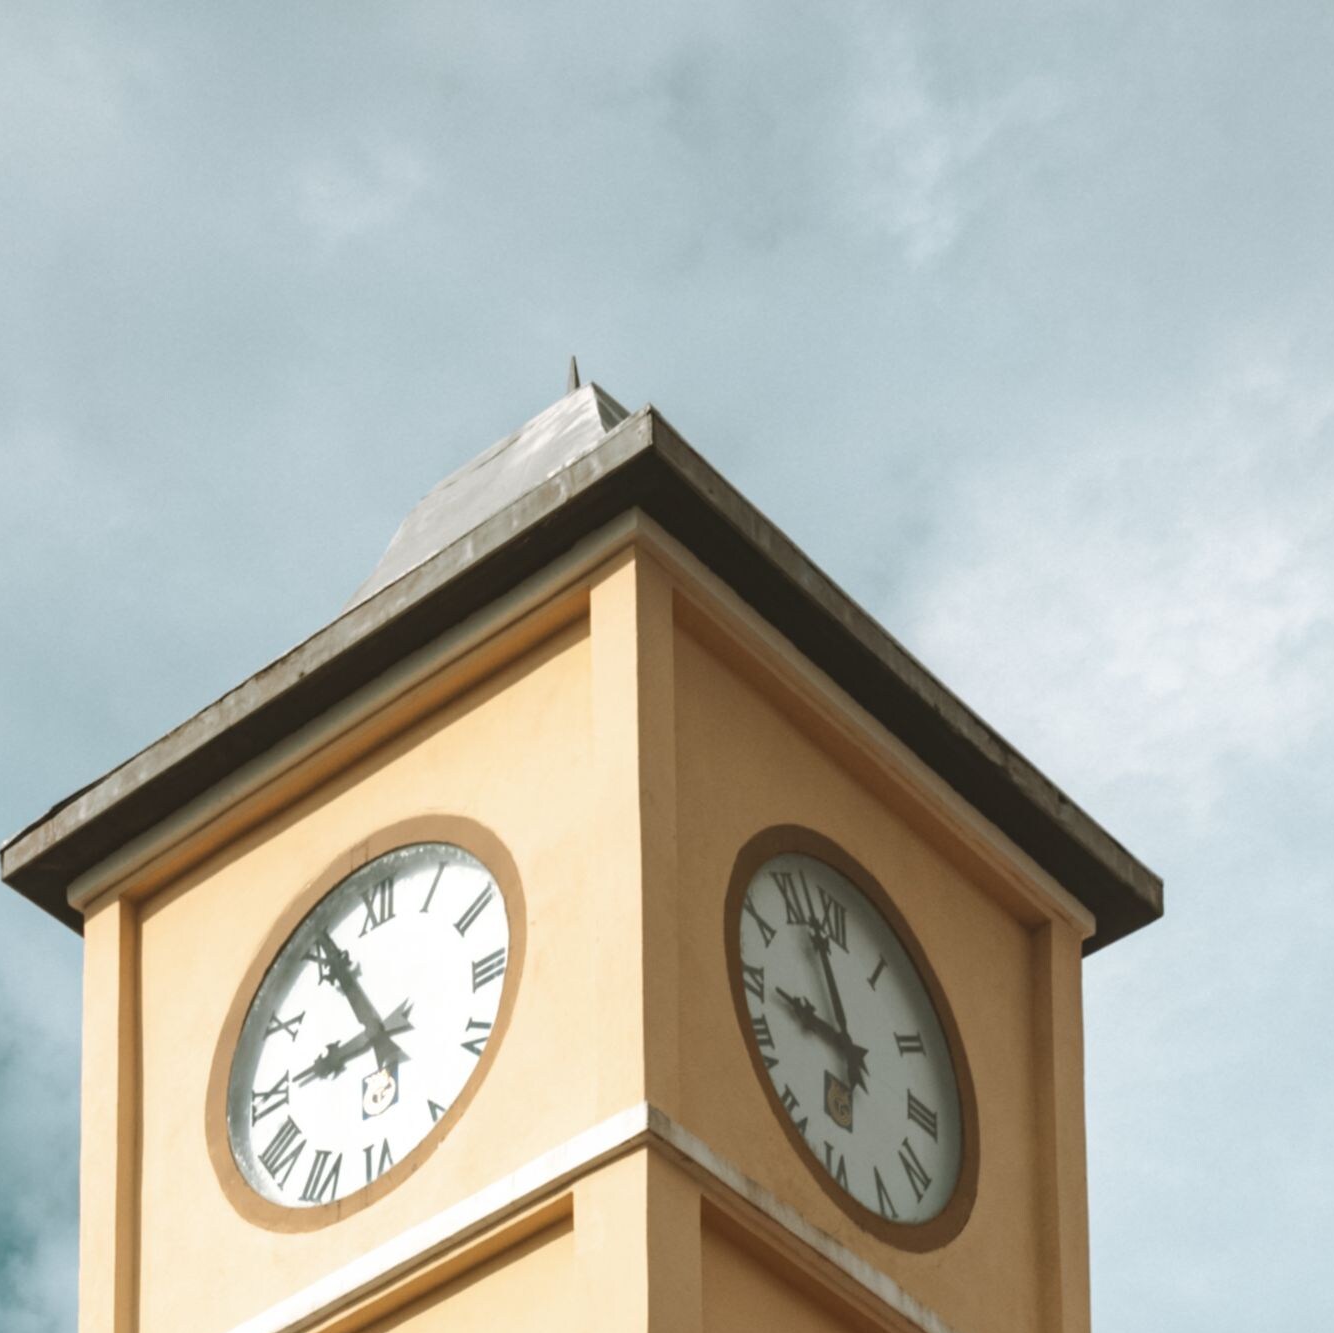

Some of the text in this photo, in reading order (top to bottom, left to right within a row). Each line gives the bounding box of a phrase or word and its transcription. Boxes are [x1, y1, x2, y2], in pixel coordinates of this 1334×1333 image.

[359, 876, 396, 938] XII
[453, 881, 497, 937] II
[817, 885, 849, 953] XII
[472, 948, 506, 993] III
[263, 1009, 306, 1042] X
[894, 1031, 926, 1057] II
[907, 1089, 938, 1144] III
[258, 1115, 308, 1191] VIII
[299, 1149, 343, 1201] VII
[364, 1137, 395, 1184] VI
[898, 1137, 933, 1202] IV
